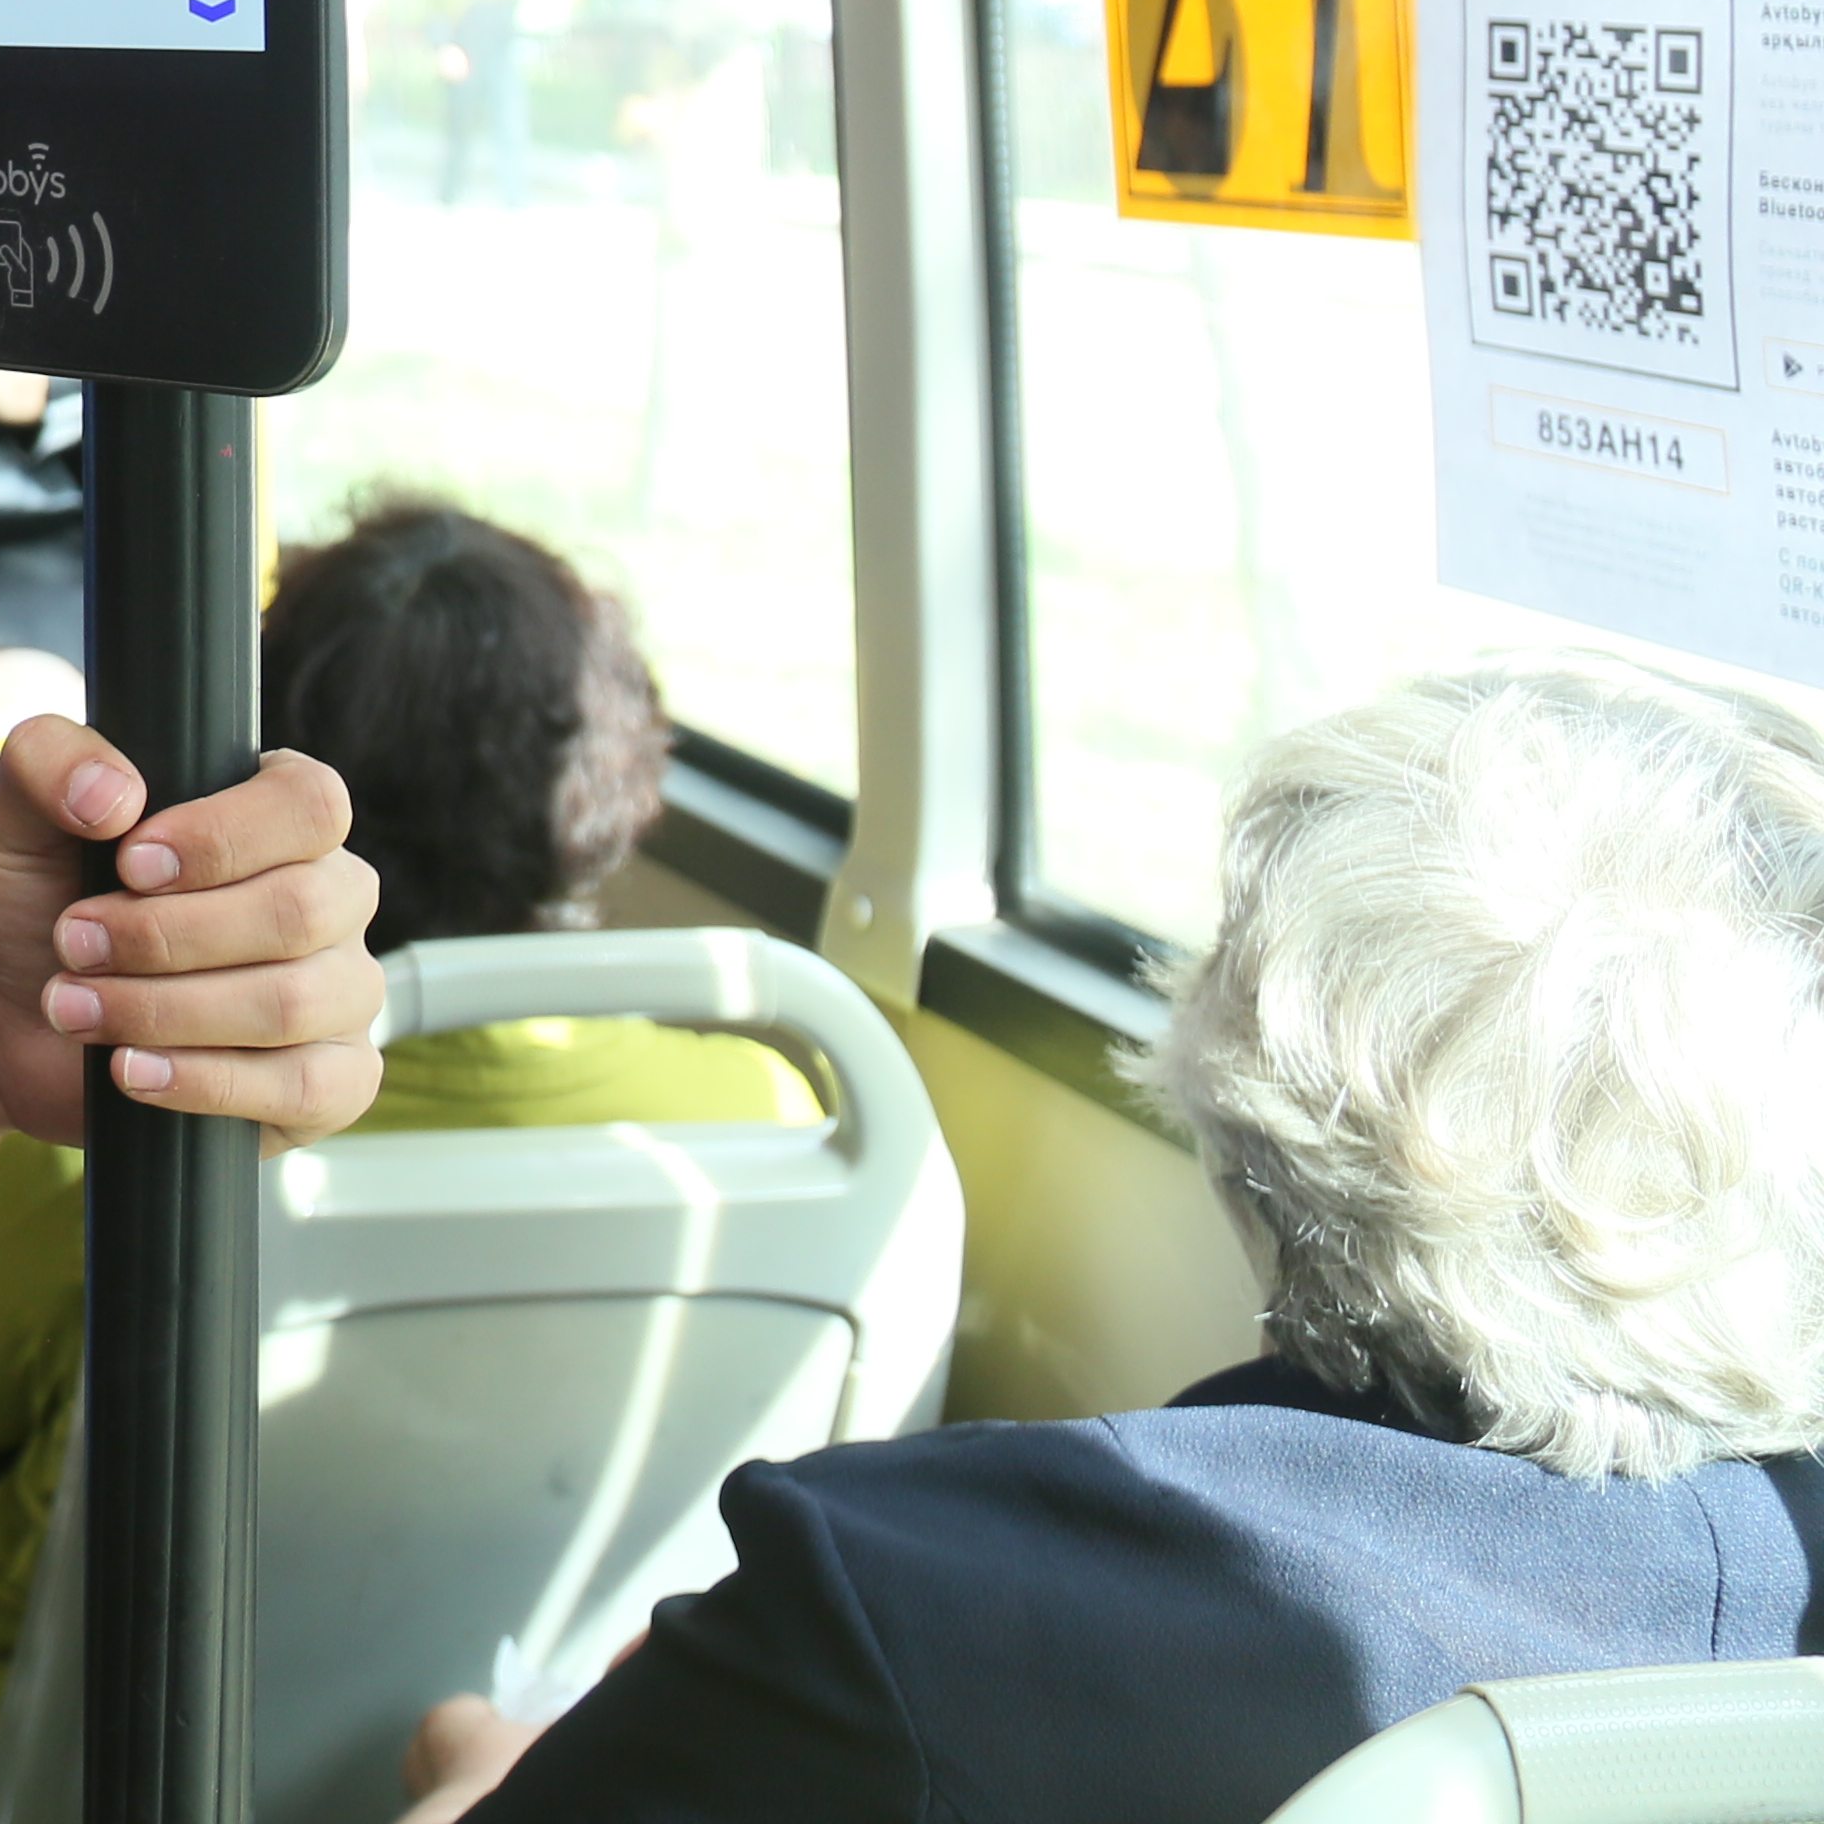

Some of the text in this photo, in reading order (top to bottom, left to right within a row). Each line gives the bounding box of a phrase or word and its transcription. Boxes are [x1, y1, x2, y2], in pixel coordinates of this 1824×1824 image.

[1760, 2, 1824, 26] Avtoby
[1760, 32, 1824, 53] арқыл
[1537, 409, 1684, 471] 853AH14
[1771, 427, 1824, 454] Avtob
[1779, 602, 1824, 627] авто
